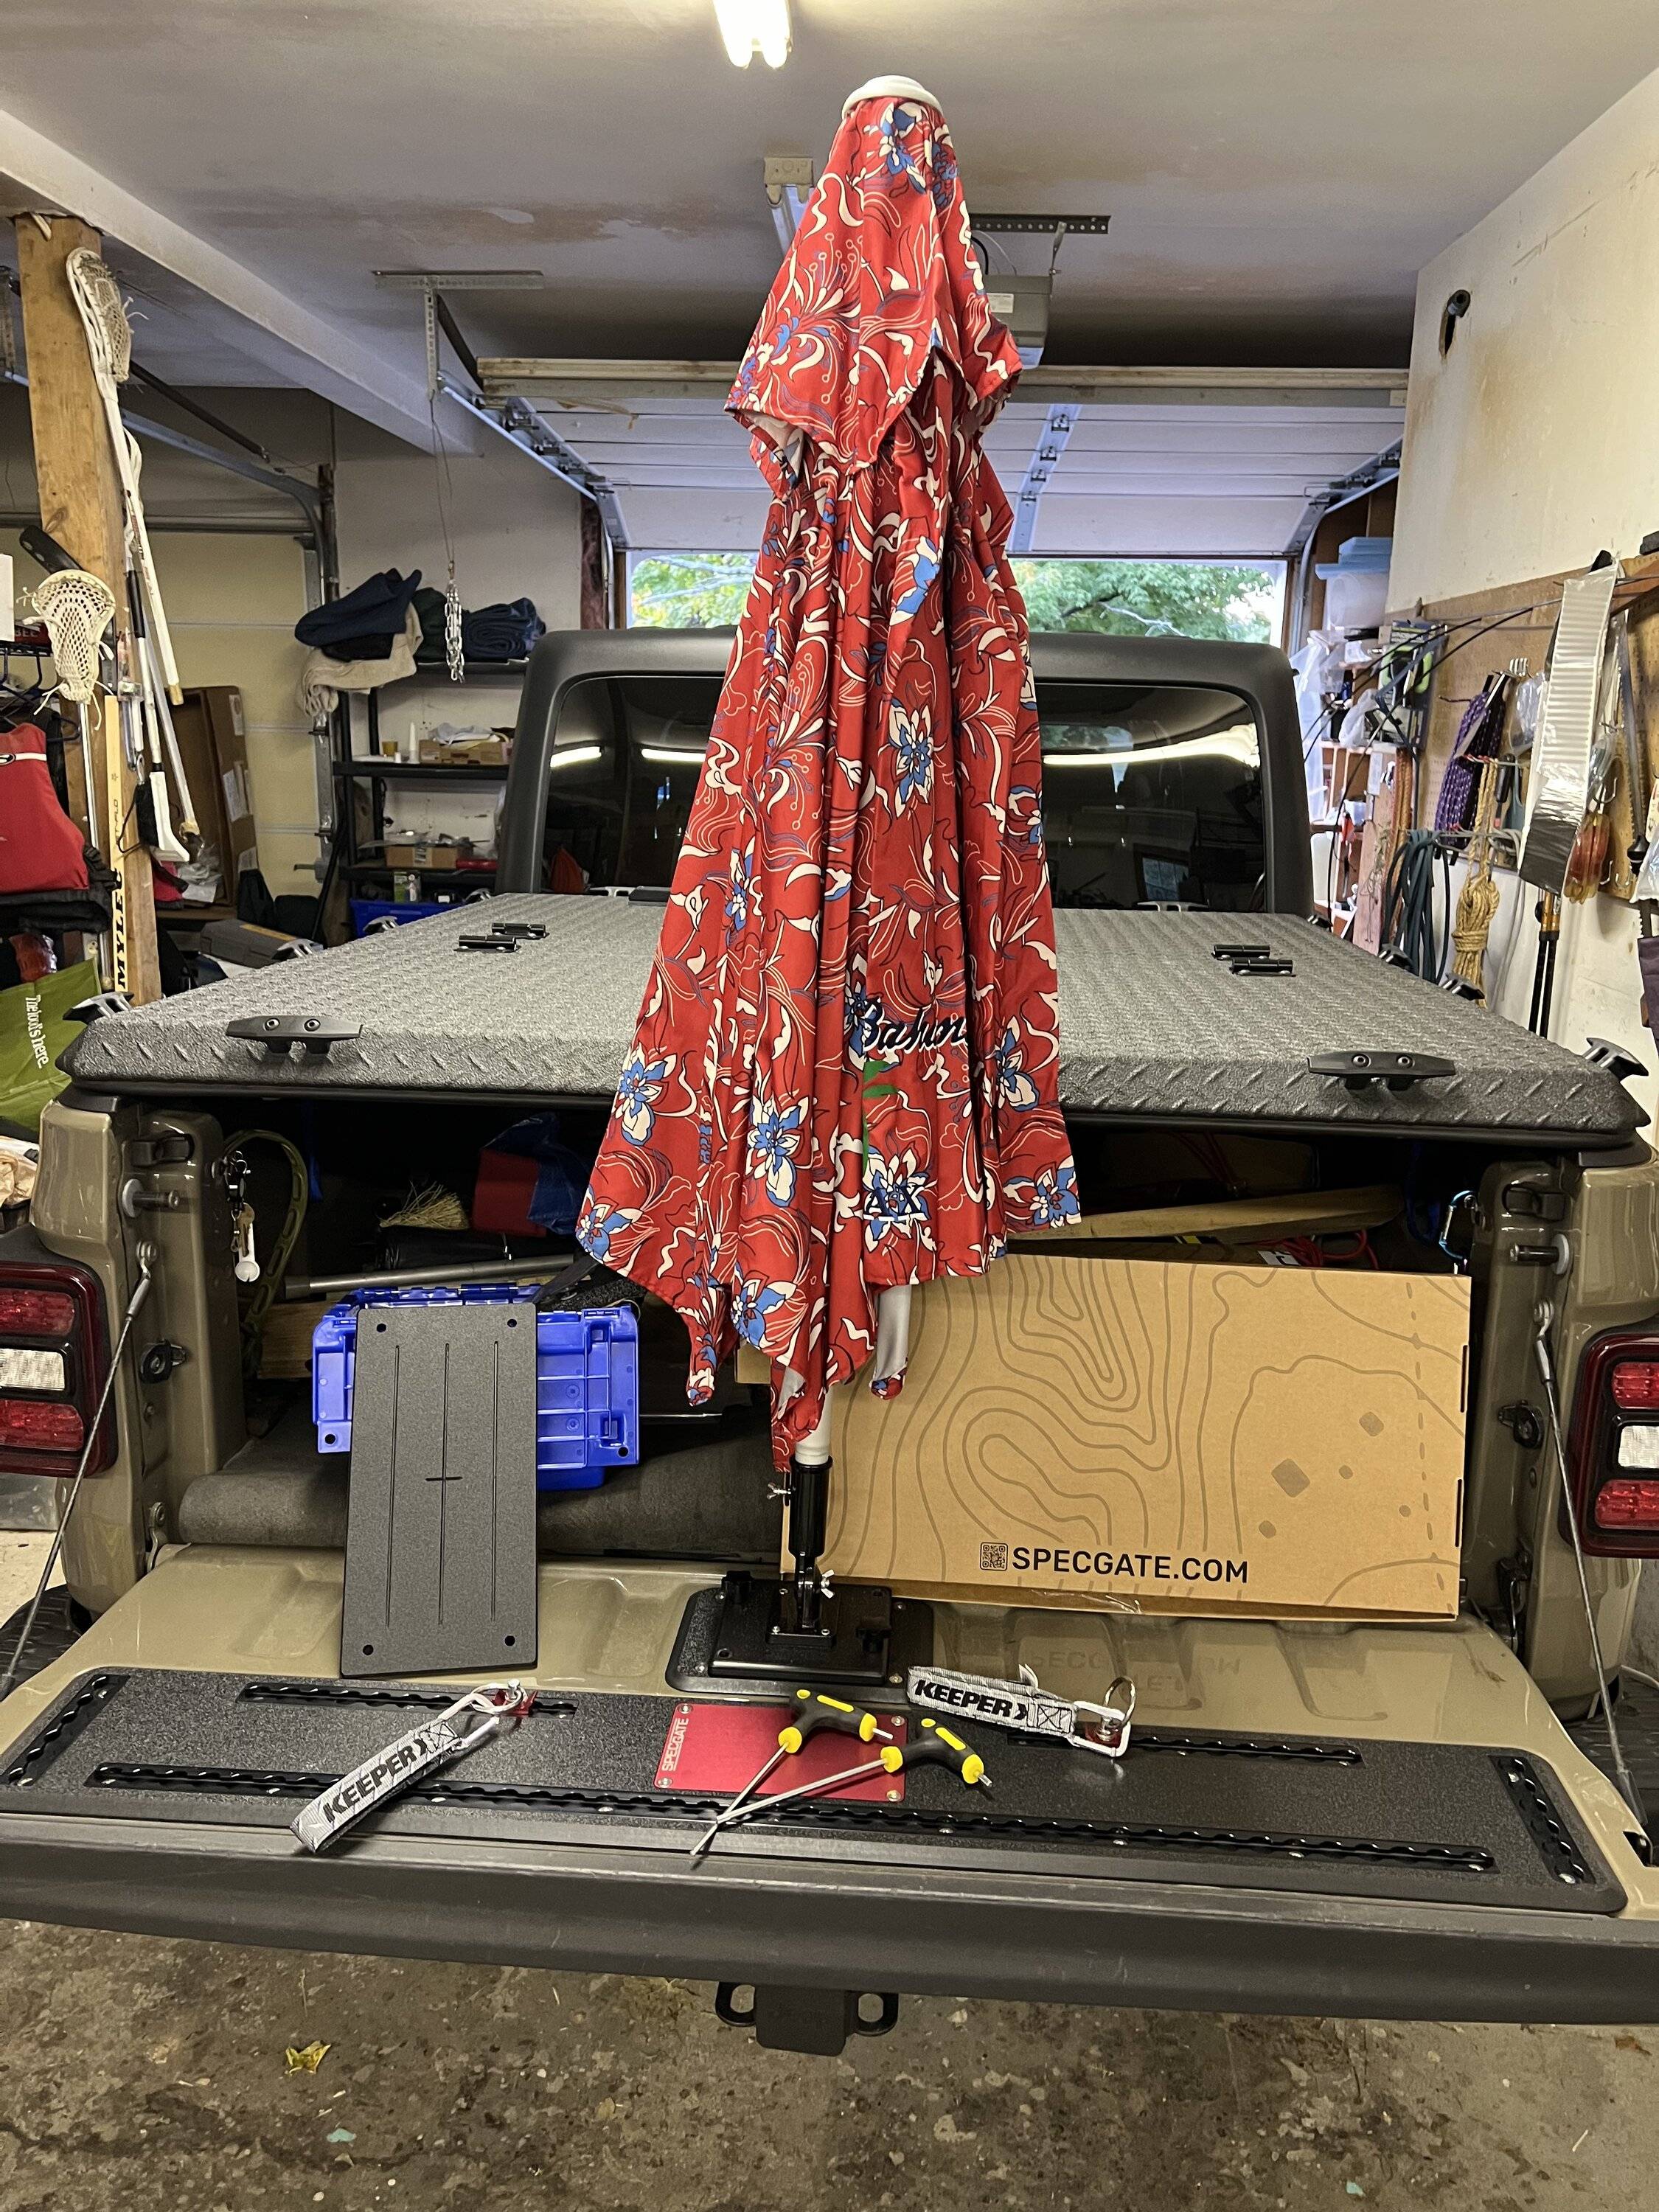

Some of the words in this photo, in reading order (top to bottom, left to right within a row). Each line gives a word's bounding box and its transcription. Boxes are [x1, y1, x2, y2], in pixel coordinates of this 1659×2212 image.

[26, 995, 41, 1012] The
[1012, 1547, 1248, 1584] SPECGATE.COM
[914, 1680, 1012, 1719] KEEPER
[662, 1718, 689, 1772] SPECGATE
[322, 1747, 419, 1823] KEEPER
